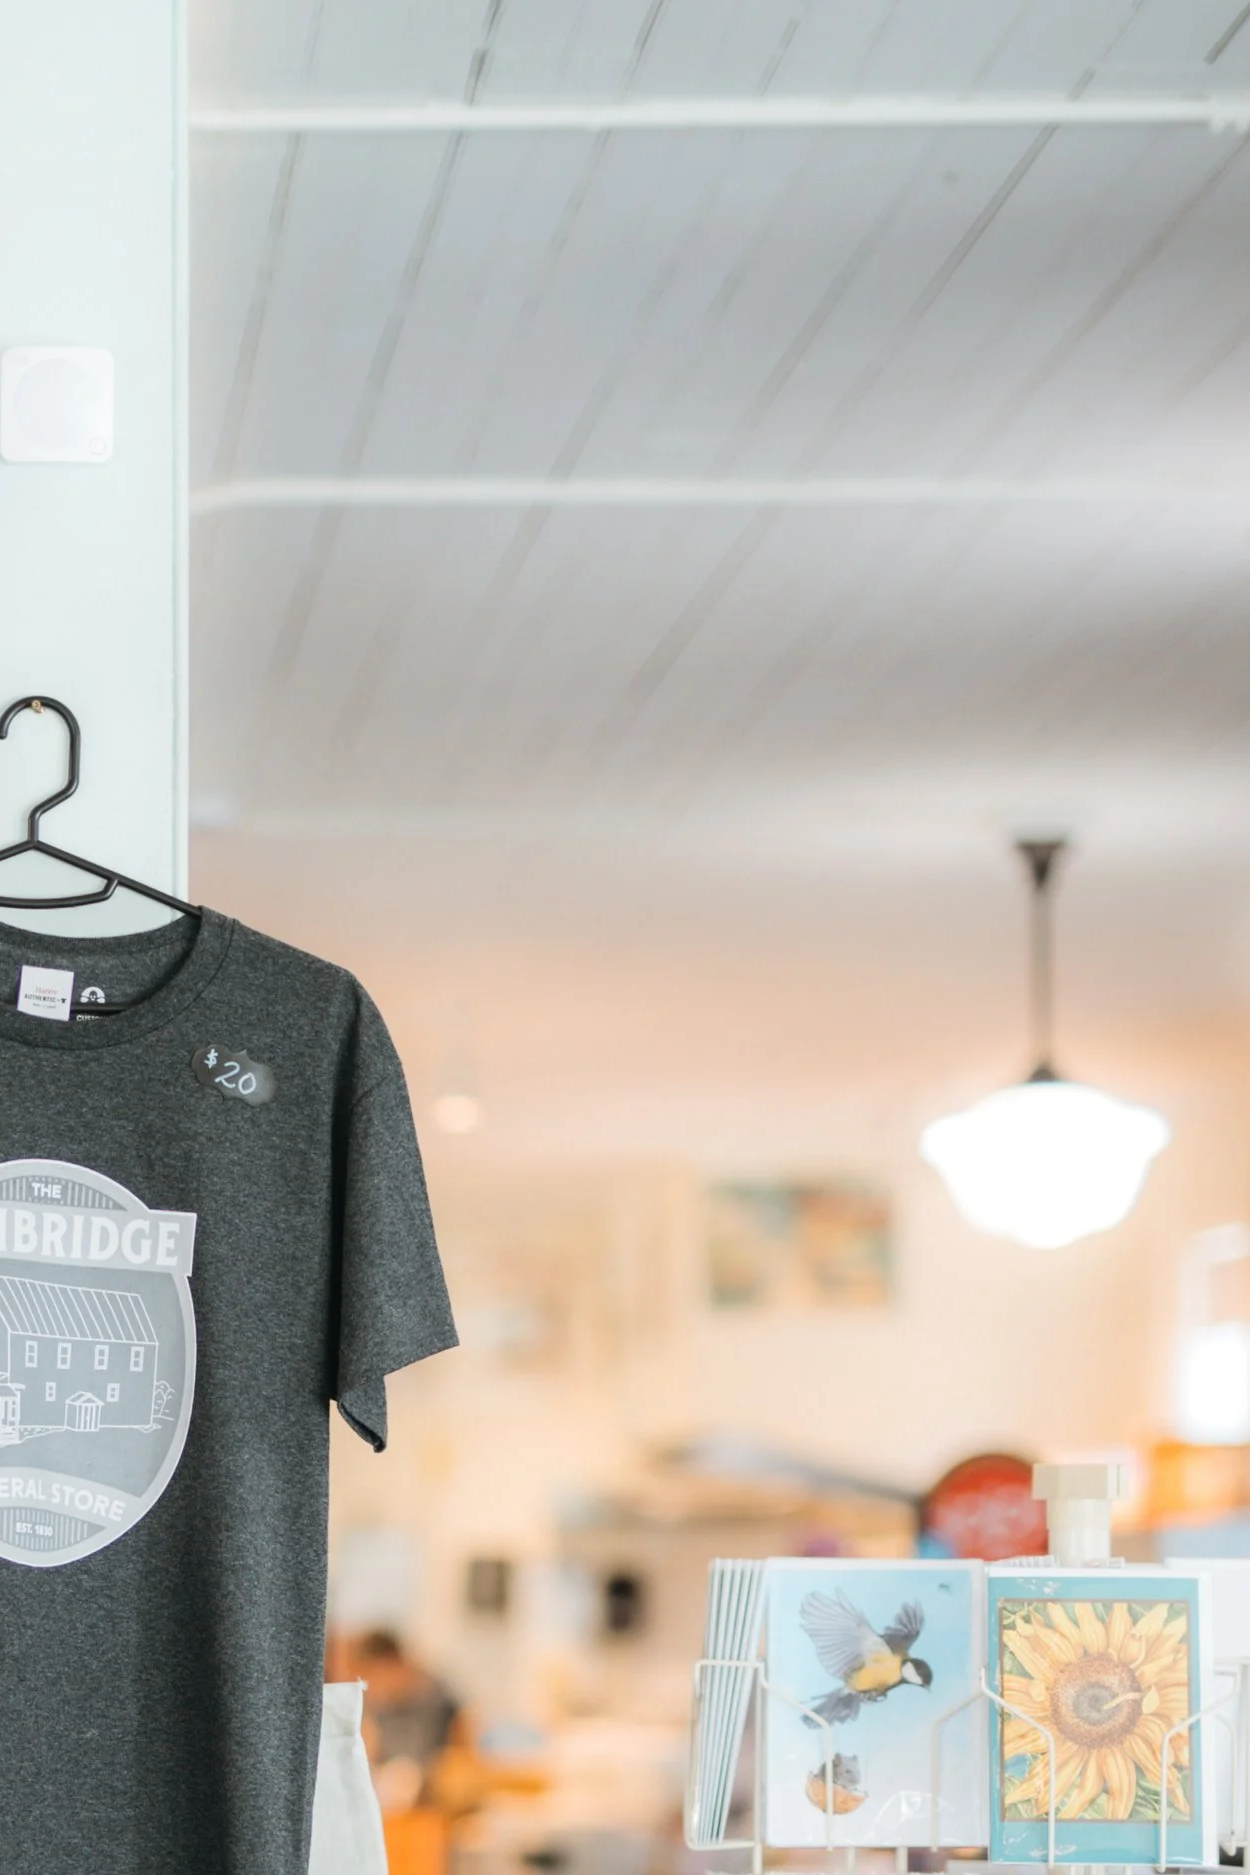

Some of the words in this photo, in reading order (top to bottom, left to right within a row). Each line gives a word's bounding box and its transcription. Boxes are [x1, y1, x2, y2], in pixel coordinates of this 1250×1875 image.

[203, 1048, 257, 1095] $20
[31, 1182, 62, 1199] THE
[51, 1483, 127, 1522] STORE
[15, 1522, 32, 1534] EST.
